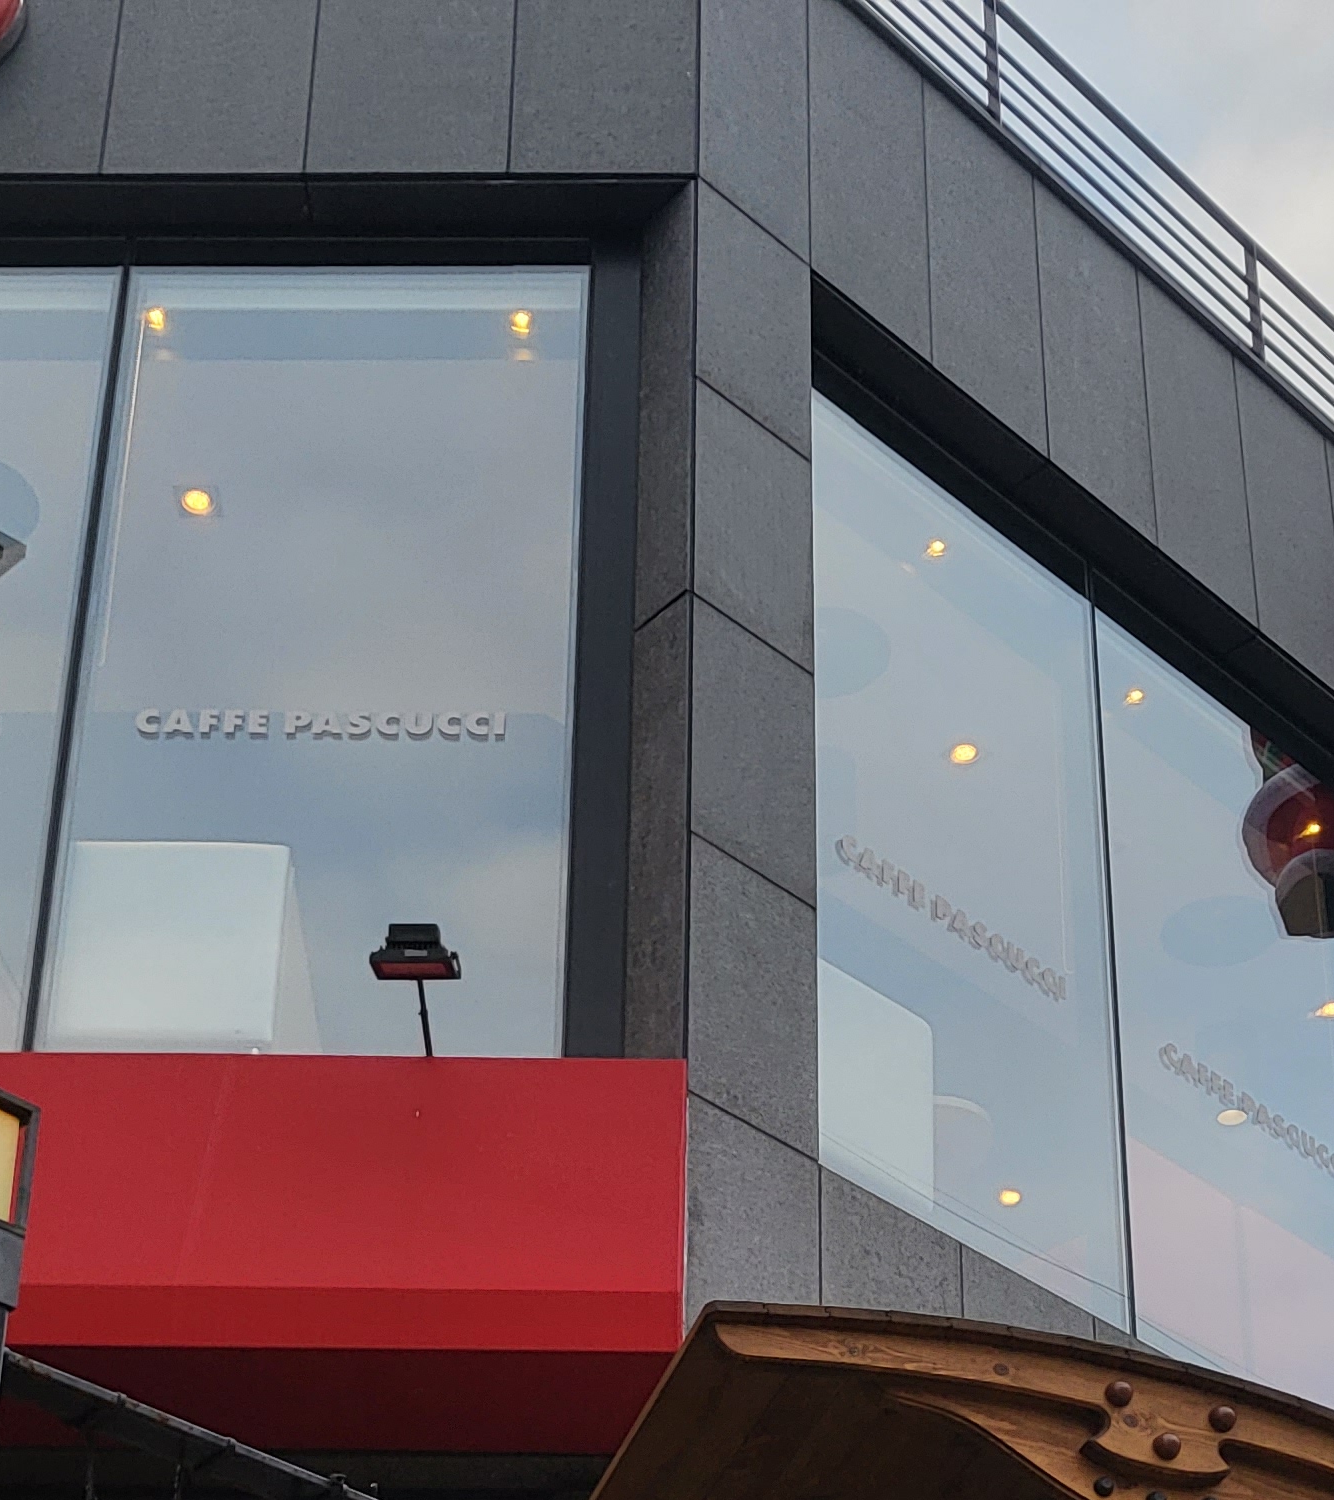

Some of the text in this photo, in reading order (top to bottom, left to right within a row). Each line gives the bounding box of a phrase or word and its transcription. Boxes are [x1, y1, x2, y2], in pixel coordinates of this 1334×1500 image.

[134, 707, 507, 742] CAFFE PASCUCCI
[836, 835, 1066, 1001] CAFFE PASCUCCI
[1159, 1043, 1236, 1106] CAFFE
